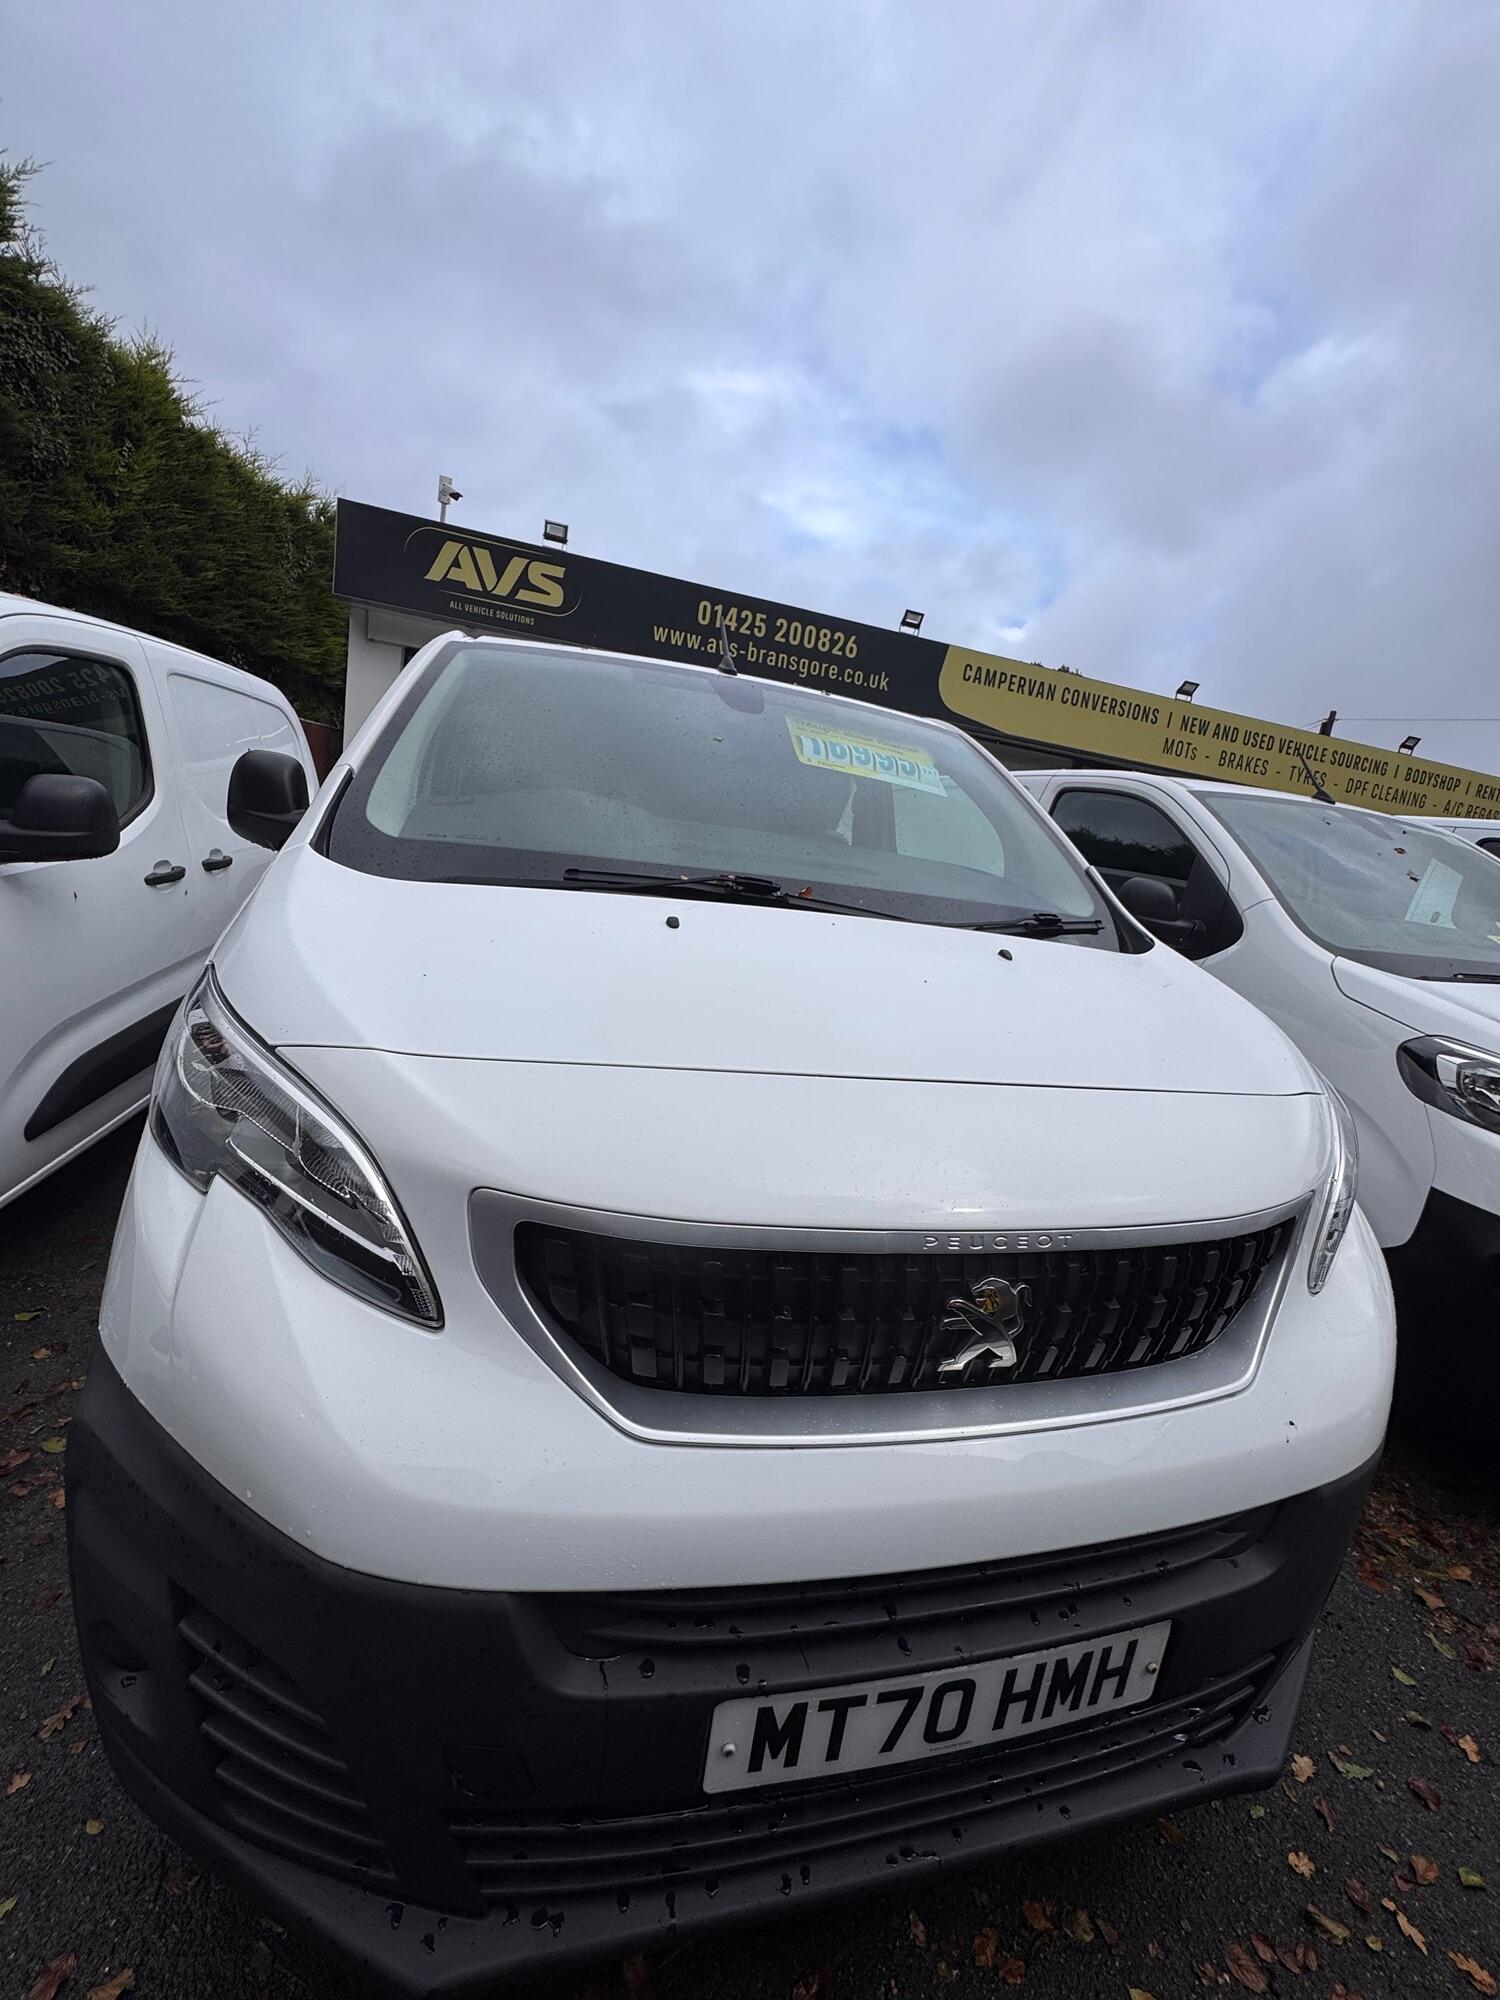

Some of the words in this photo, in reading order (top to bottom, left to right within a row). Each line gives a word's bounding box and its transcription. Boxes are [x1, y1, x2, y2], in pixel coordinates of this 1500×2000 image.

[424, 540, 566, 608] AVS
[449, 600, 463, 612] ALL
[464, 603, 494, 617] VEHICLE
[496, 610, 535, 626] SOLUTIONS
[697, 600, 767, 638] 01425
[774, 618, 858, 659] 200826
[962, 663, 1057, 702] CAMPERVAN
[1061, 686, 1160, 725] CONVERSIONS
[1180, 715, 1210, 736] NEW
[1212, 723, 1239, 743] AND
[1243, 729, 1275, 751] USED
[1279, 737, 1329, 763] VEHICLE
[1330, 749, 1389, 778] SOURCING
[1404, 767, 1461, 793] BODYSHOP
[1162, 737, 1198, 761] MOTs
[1218, 750, 1269, 776] BRAKES
[1289, 765, 1327, 787] TYRES
[1345, 778, 1369, 797] DPF
[1371, 783, 1428, 809] CLEANING
[1443, 800, 1464, 817] A/C
[923, 1235, 1072, 1250] PEUGEOT
[747, 1677, 977, 1774] MT70
[991, 1639, 1140, 1732] HMH
